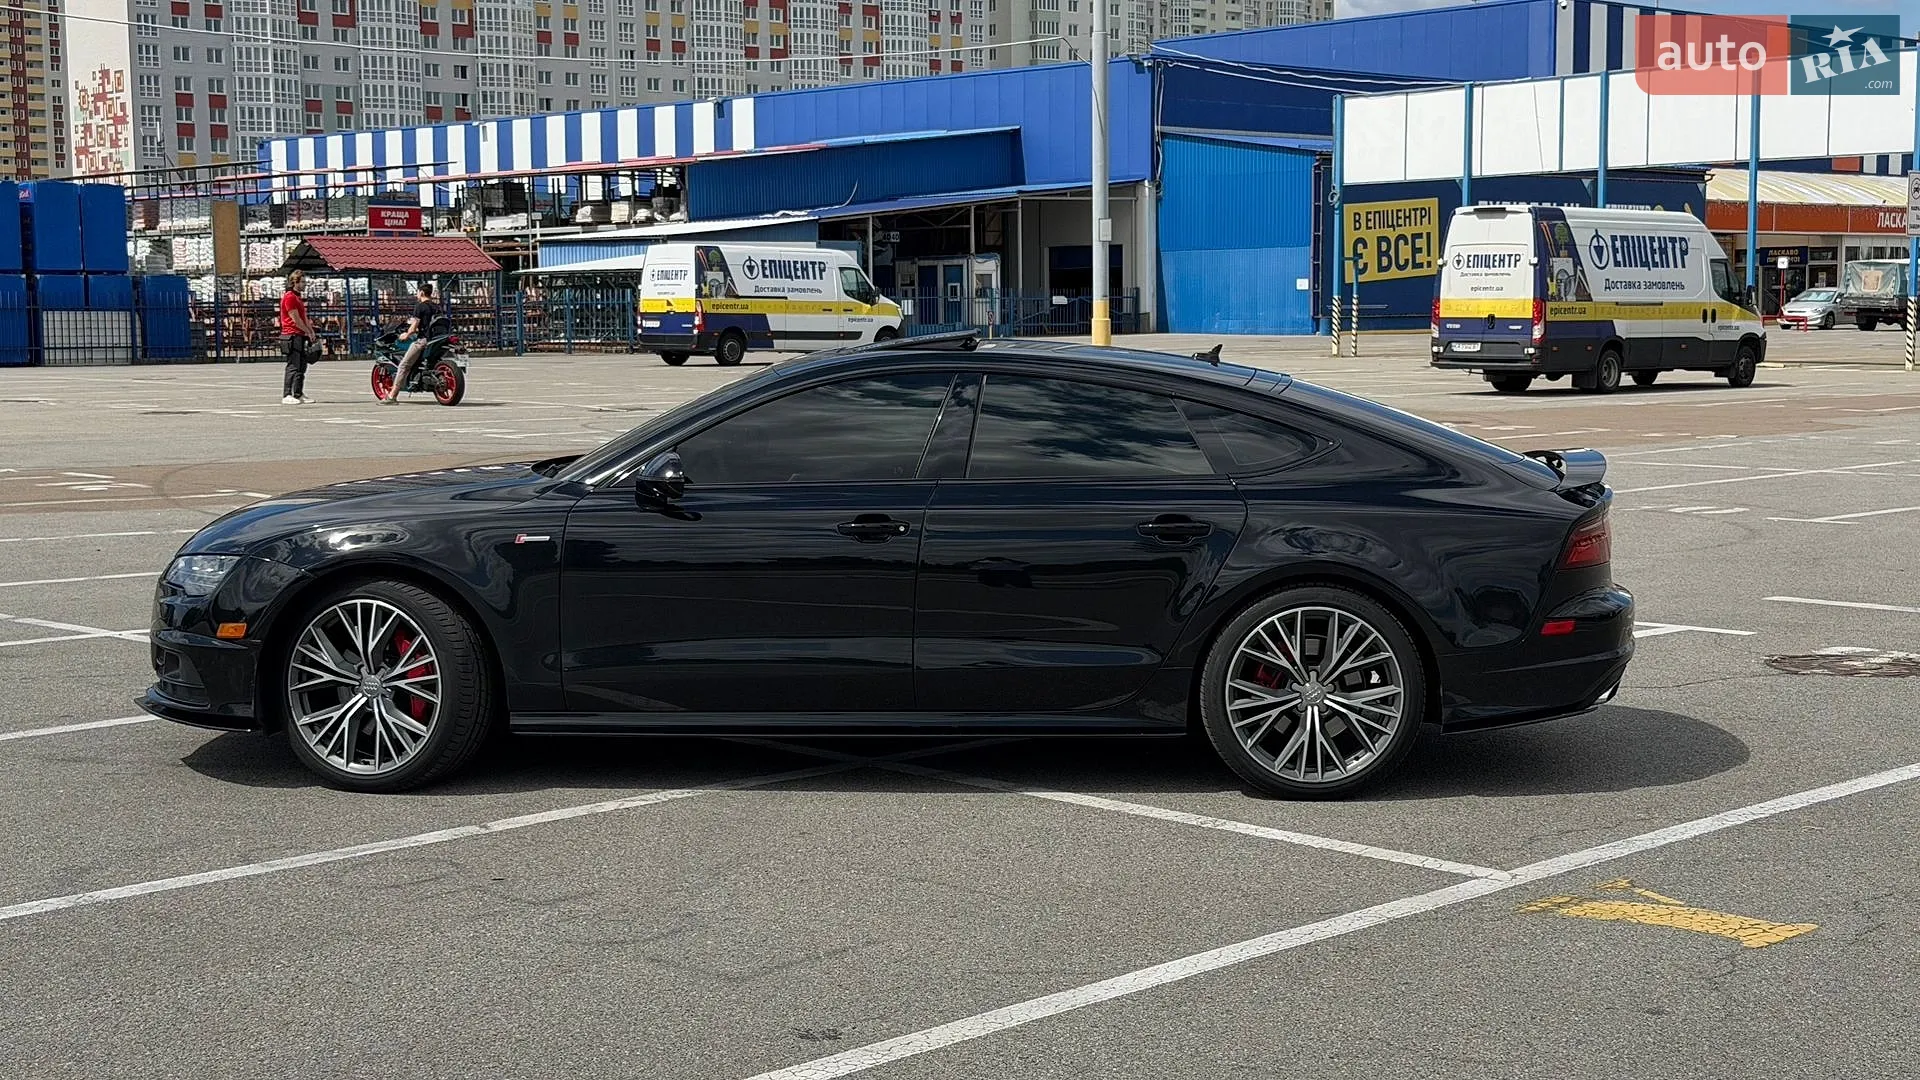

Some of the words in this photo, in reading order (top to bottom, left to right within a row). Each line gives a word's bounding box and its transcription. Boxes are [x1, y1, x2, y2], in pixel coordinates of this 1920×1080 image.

[381, 211, 409, 219] КРАЩА
[1353, 212, 1362, 231] В
[1365, 207, 1431, 232] ЕПІЦЕНТРІ
[1353, 237, 1368, 275] Є
[1377, 232, 1432, 273] ВСЕ!
[1610, 234, 1689, 271] ЕПІЦЕНТР
[1466, 253, 1522, 269] ЕПІЦЕНТР
[760, 259, 827, 282] ЕПІЦЕНТР
[754, 285, 785, 294] Доставка
[787, 286, 823, 294] замовлень
[1604, 278, 1641, 291] Доставка
[1642, 280, 1685, 291] замовлень
[1550, 306, 1587, 316] epicentr.ua
